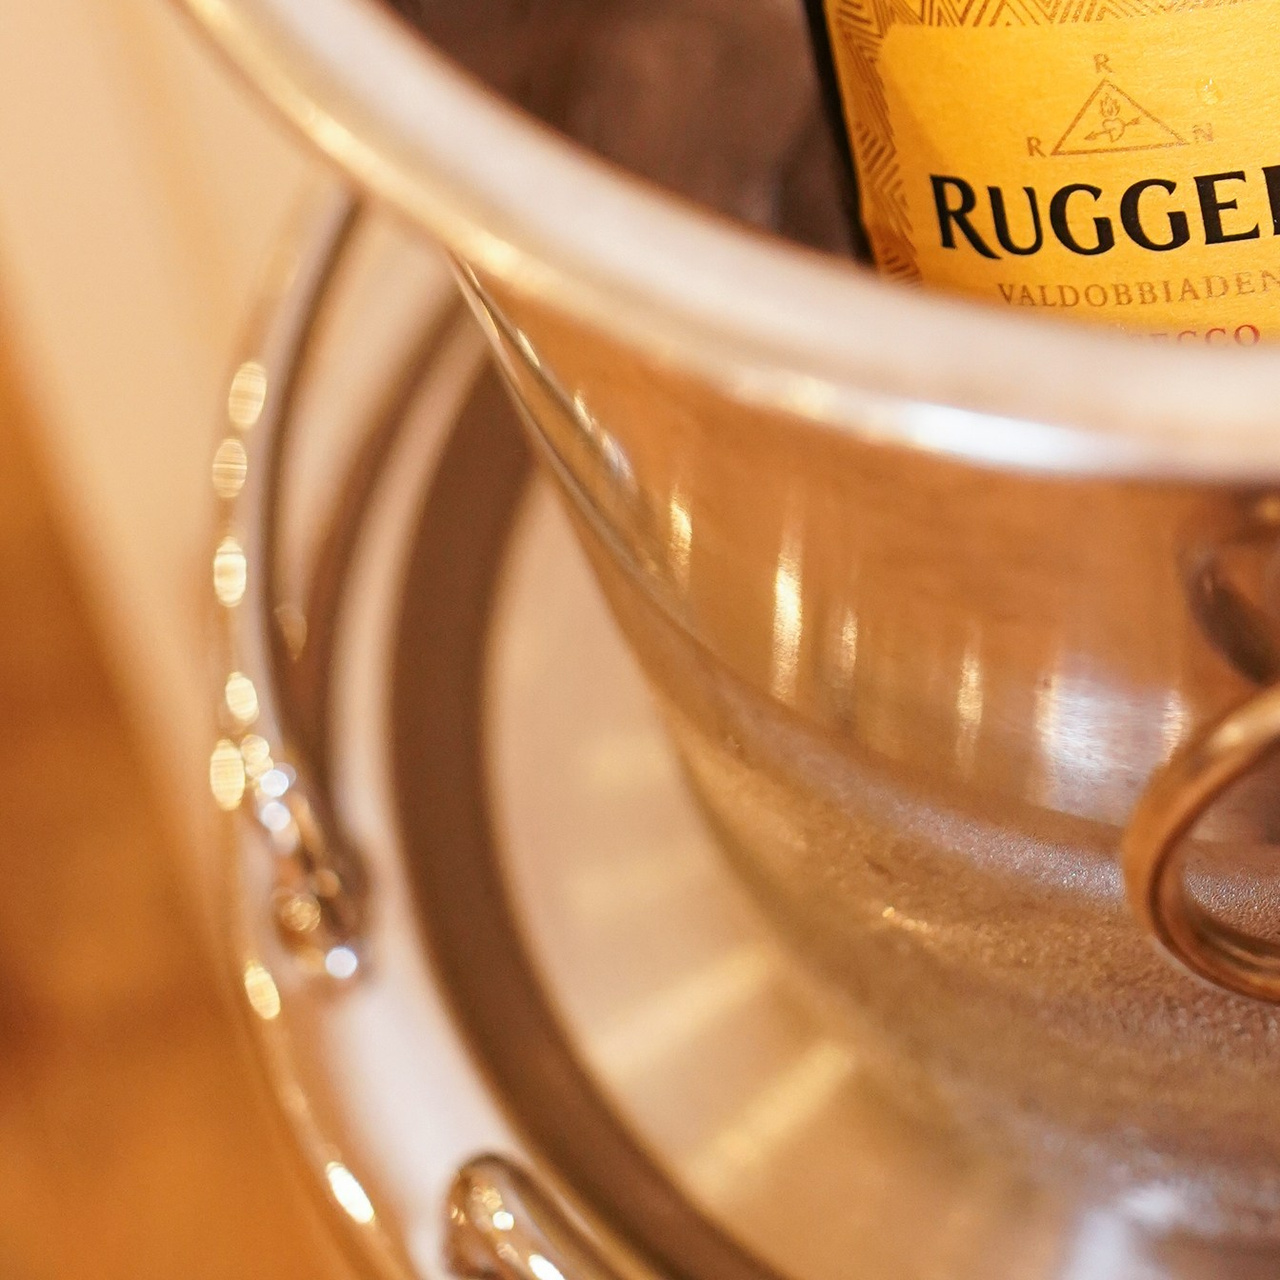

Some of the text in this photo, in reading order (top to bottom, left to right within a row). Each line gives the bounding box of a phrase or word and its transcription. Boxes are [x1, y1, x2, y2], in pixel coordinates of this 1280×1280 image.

[1093, 53, 1113, 74] R
[1026, 122, 1214, 158] R N
